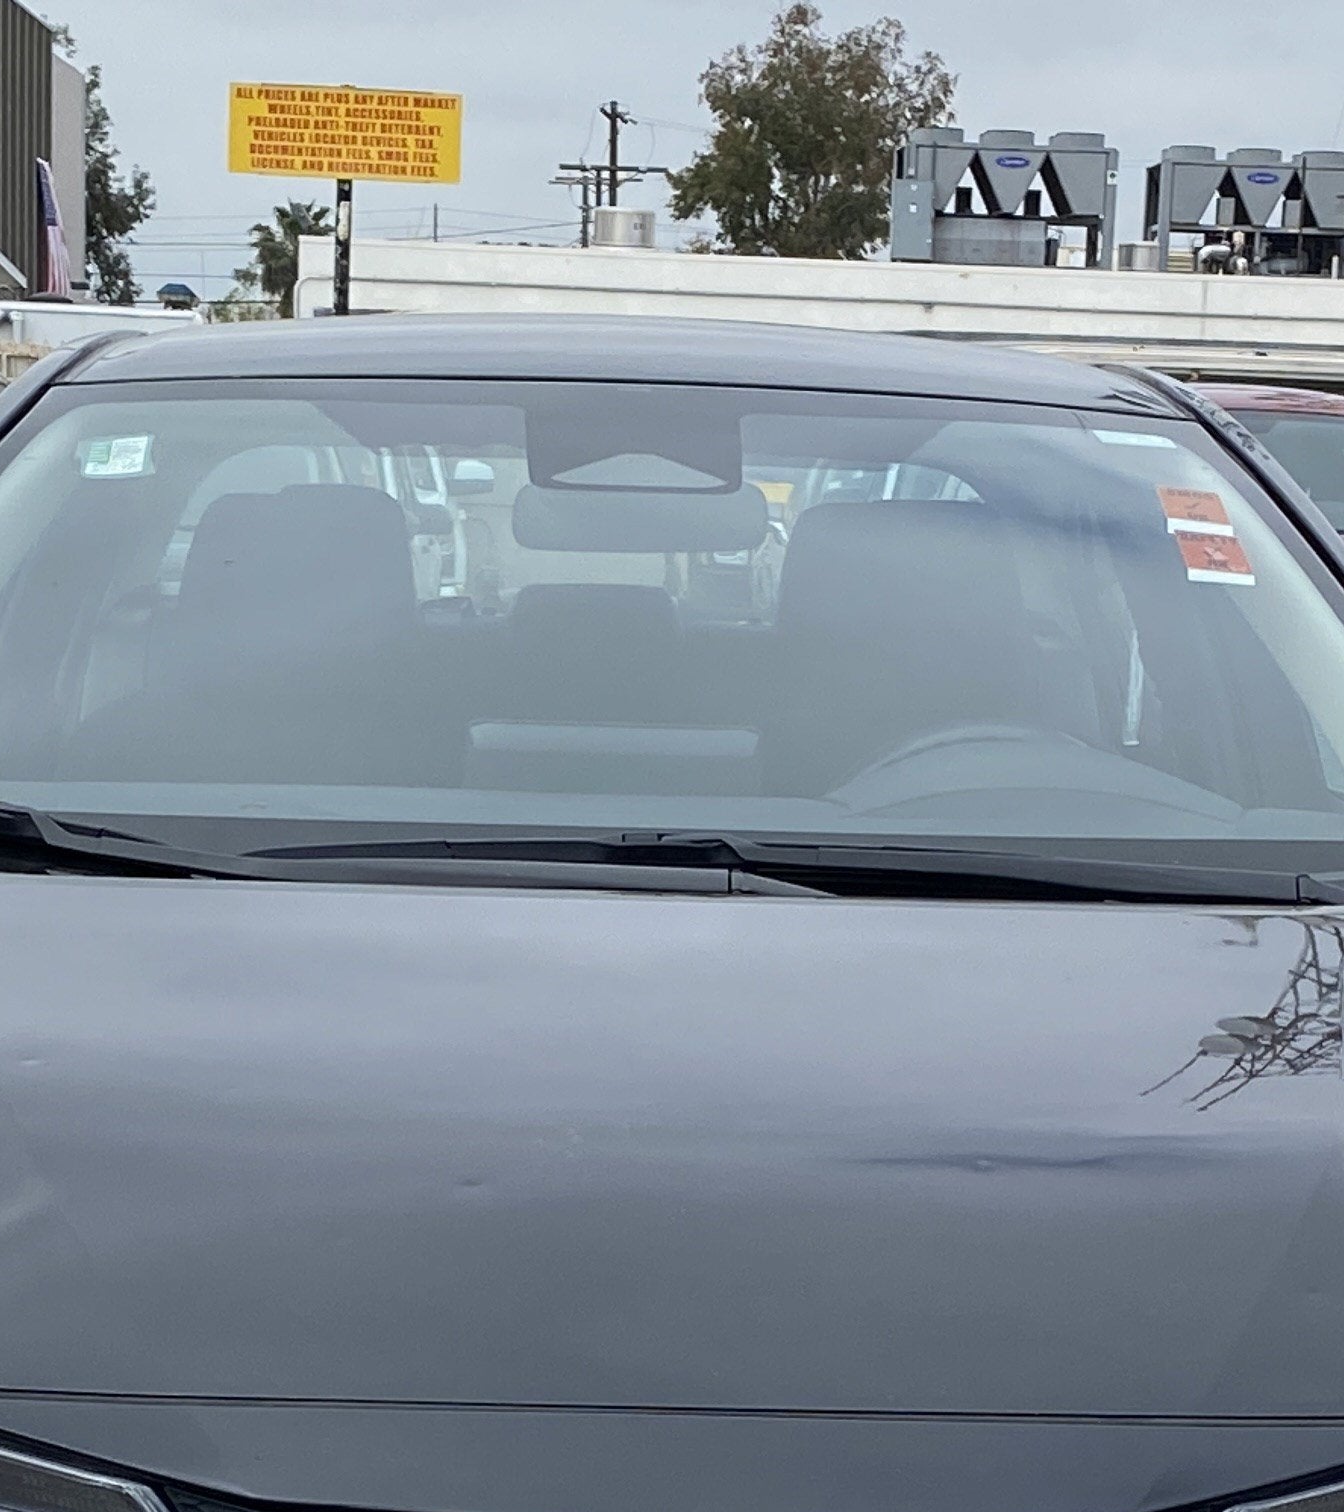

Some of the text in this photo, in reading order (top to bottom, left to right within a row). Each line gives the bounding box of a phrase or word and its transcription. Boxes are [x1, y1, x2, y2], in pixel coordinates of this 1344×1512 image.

[236, 87, 456, 109] ALL PRICES ARE PLUS ANY AFTER MARKET
[247, 115, 310, 129] PRELOADED
[309, 132, 357, 146] LOCATOR
[250, 143, 342, 159] DOCUMENTATION
[378, 150, 409, 162] SMOG
[302, 159, 324, 172] AND
[327, 160, 407, 175] REGISTRATION
